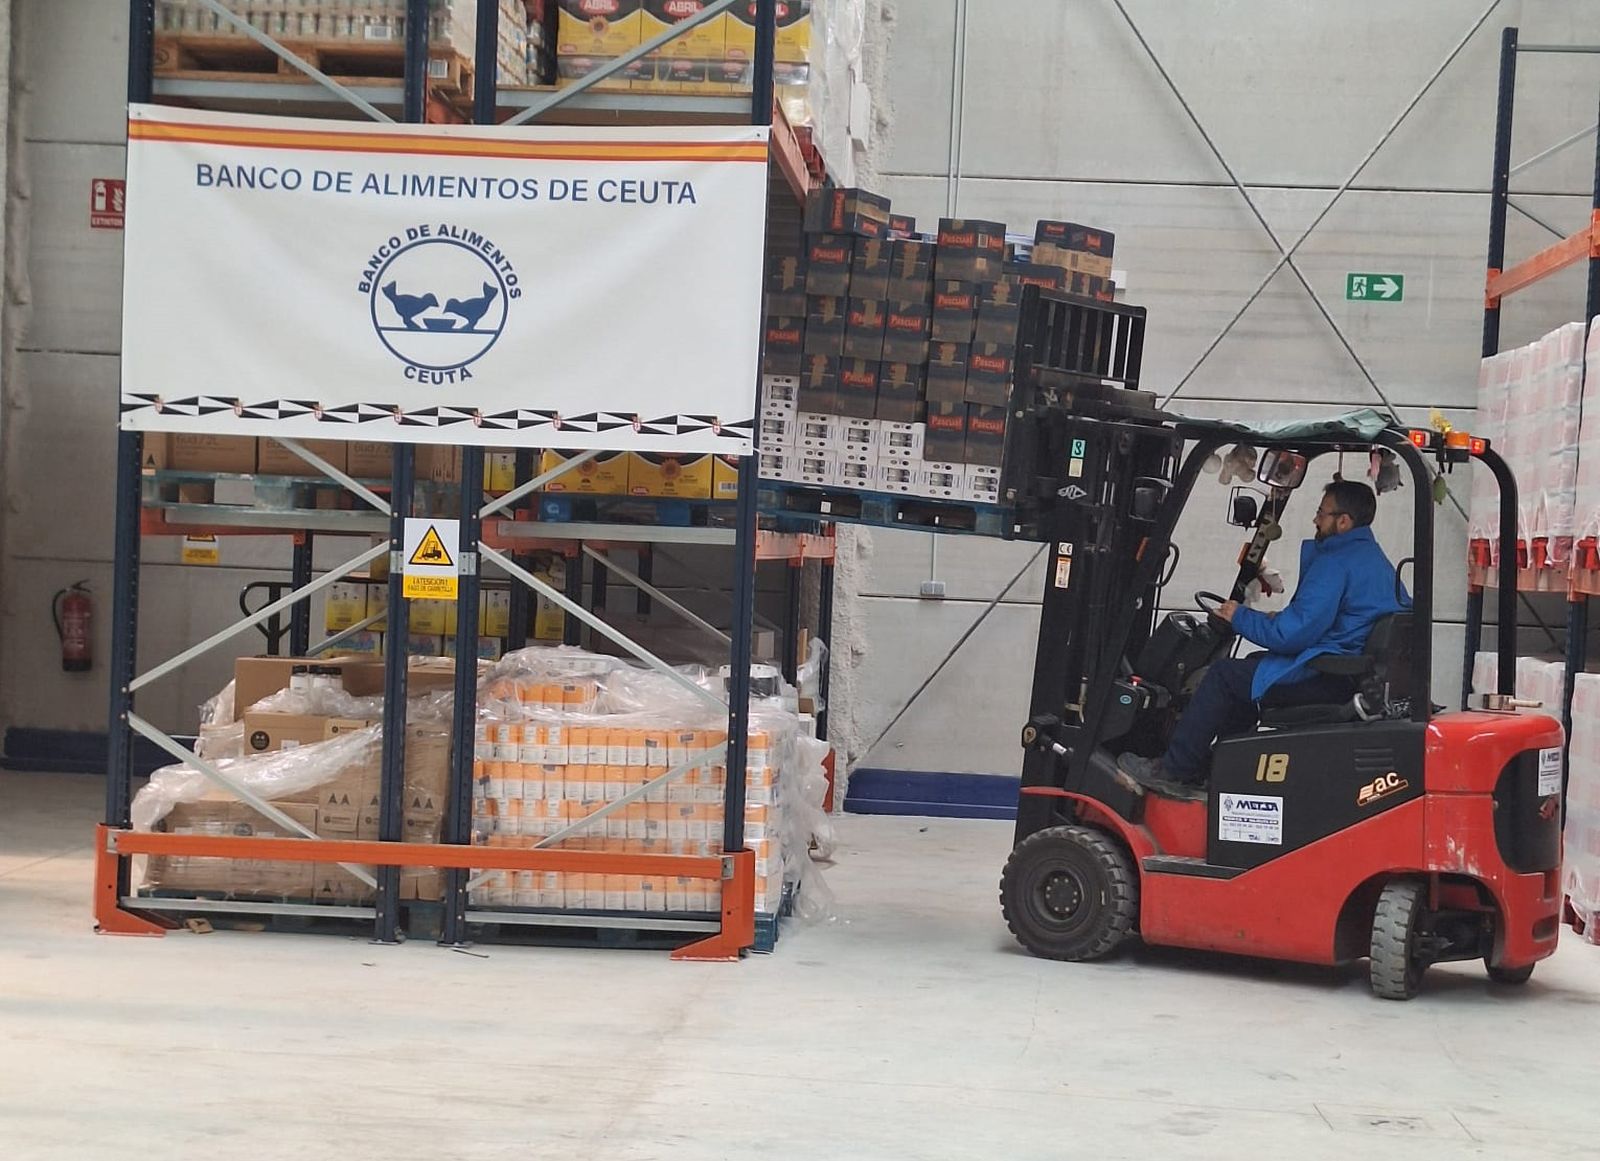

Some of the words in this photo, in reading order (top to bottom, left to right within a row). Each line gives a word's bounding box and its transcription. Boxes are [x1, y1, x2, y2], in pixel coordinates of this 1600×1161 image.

[583, 0, 616, 10] ABRIL
[668, 2, 702, 13] ABRIL
[196, 163, 302, 191] BANCO
[312, 170, 353, 193] DE
[361, 173, 538, 200] ALIMENTOS
[549, 179, 588, 202] DE
[598, 179, 697, 204] CEUTA
[941, 232, 973, 248] Pascual
[358, 236, 401, 294] BANCO
[406, 224, 431, 241] DE
[438, 223, 522, 299] ALIMENTOS
[890, 314, 921, 329] Pascual
[974, 356, 1005, 370] Pascual
[404, 365, 472, 385] CEUTA
[843, 371, 875, 385] Pascual
[972, 416, 1003, 431] Pascual
[1256, 753, 1289, 782] 18
